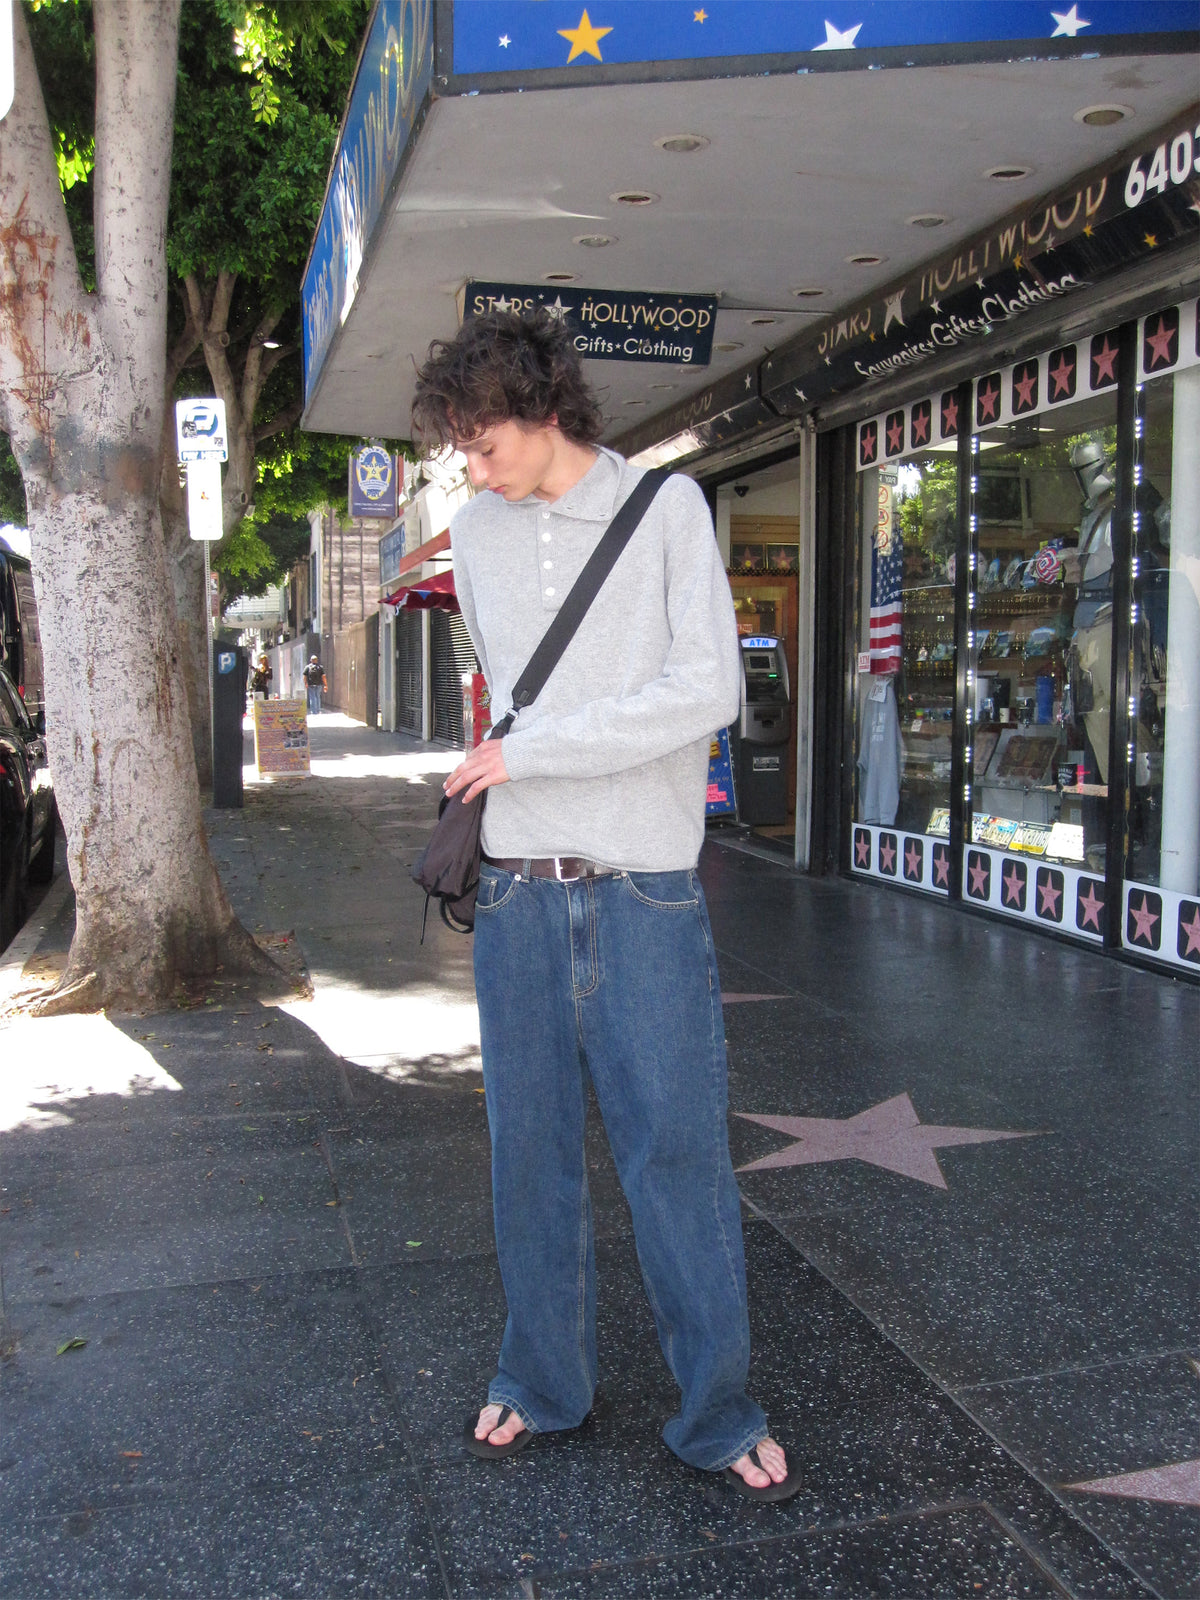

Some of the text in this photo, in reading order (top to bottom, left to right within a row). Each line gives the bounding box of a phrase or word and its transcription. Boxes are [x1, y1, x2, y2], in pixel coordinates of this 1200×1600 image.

[581, 302, 711, 328] HOLLYWOOD
[573, 335, 693, 363] Gifts Clothing
[749, 639, 769, 647] ATM
